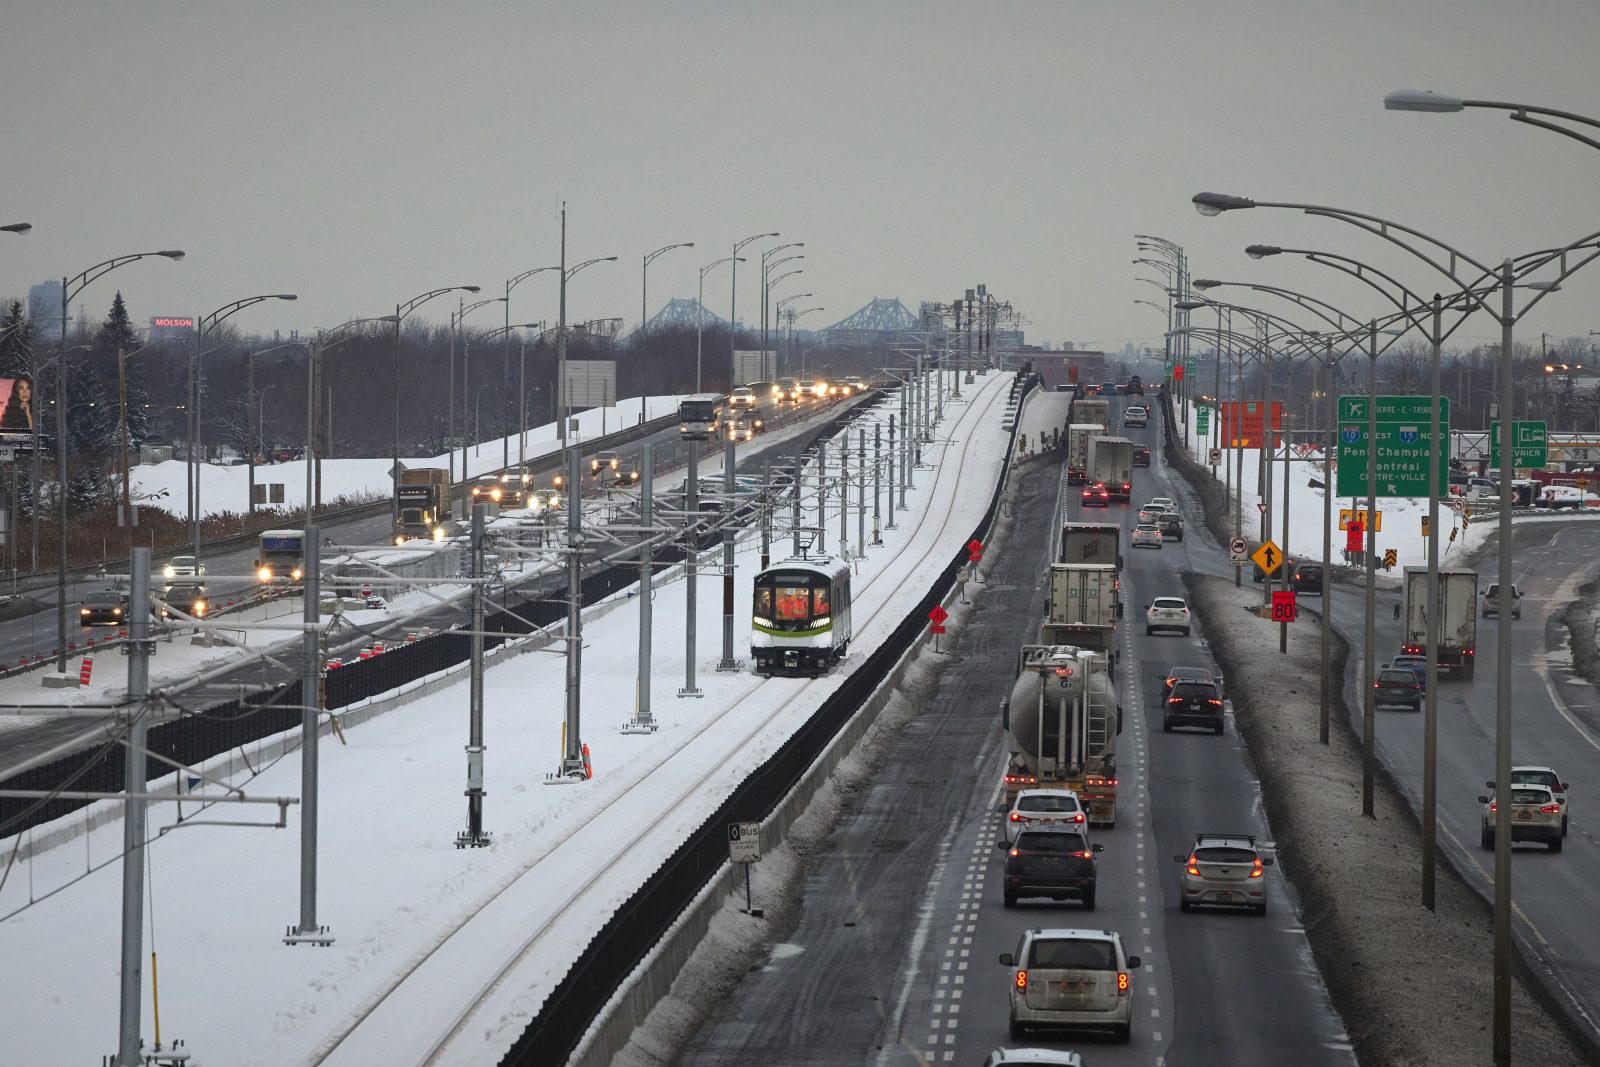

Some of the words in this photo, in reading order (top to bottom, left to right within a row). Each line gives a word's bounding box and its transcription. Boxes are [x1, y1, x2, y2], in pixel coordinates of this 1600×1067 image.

[155, 319, 192, 327] MOLSON
[1366, 462, 1420, 470] ontréal
[1276, 603, 1293, 618] 80
